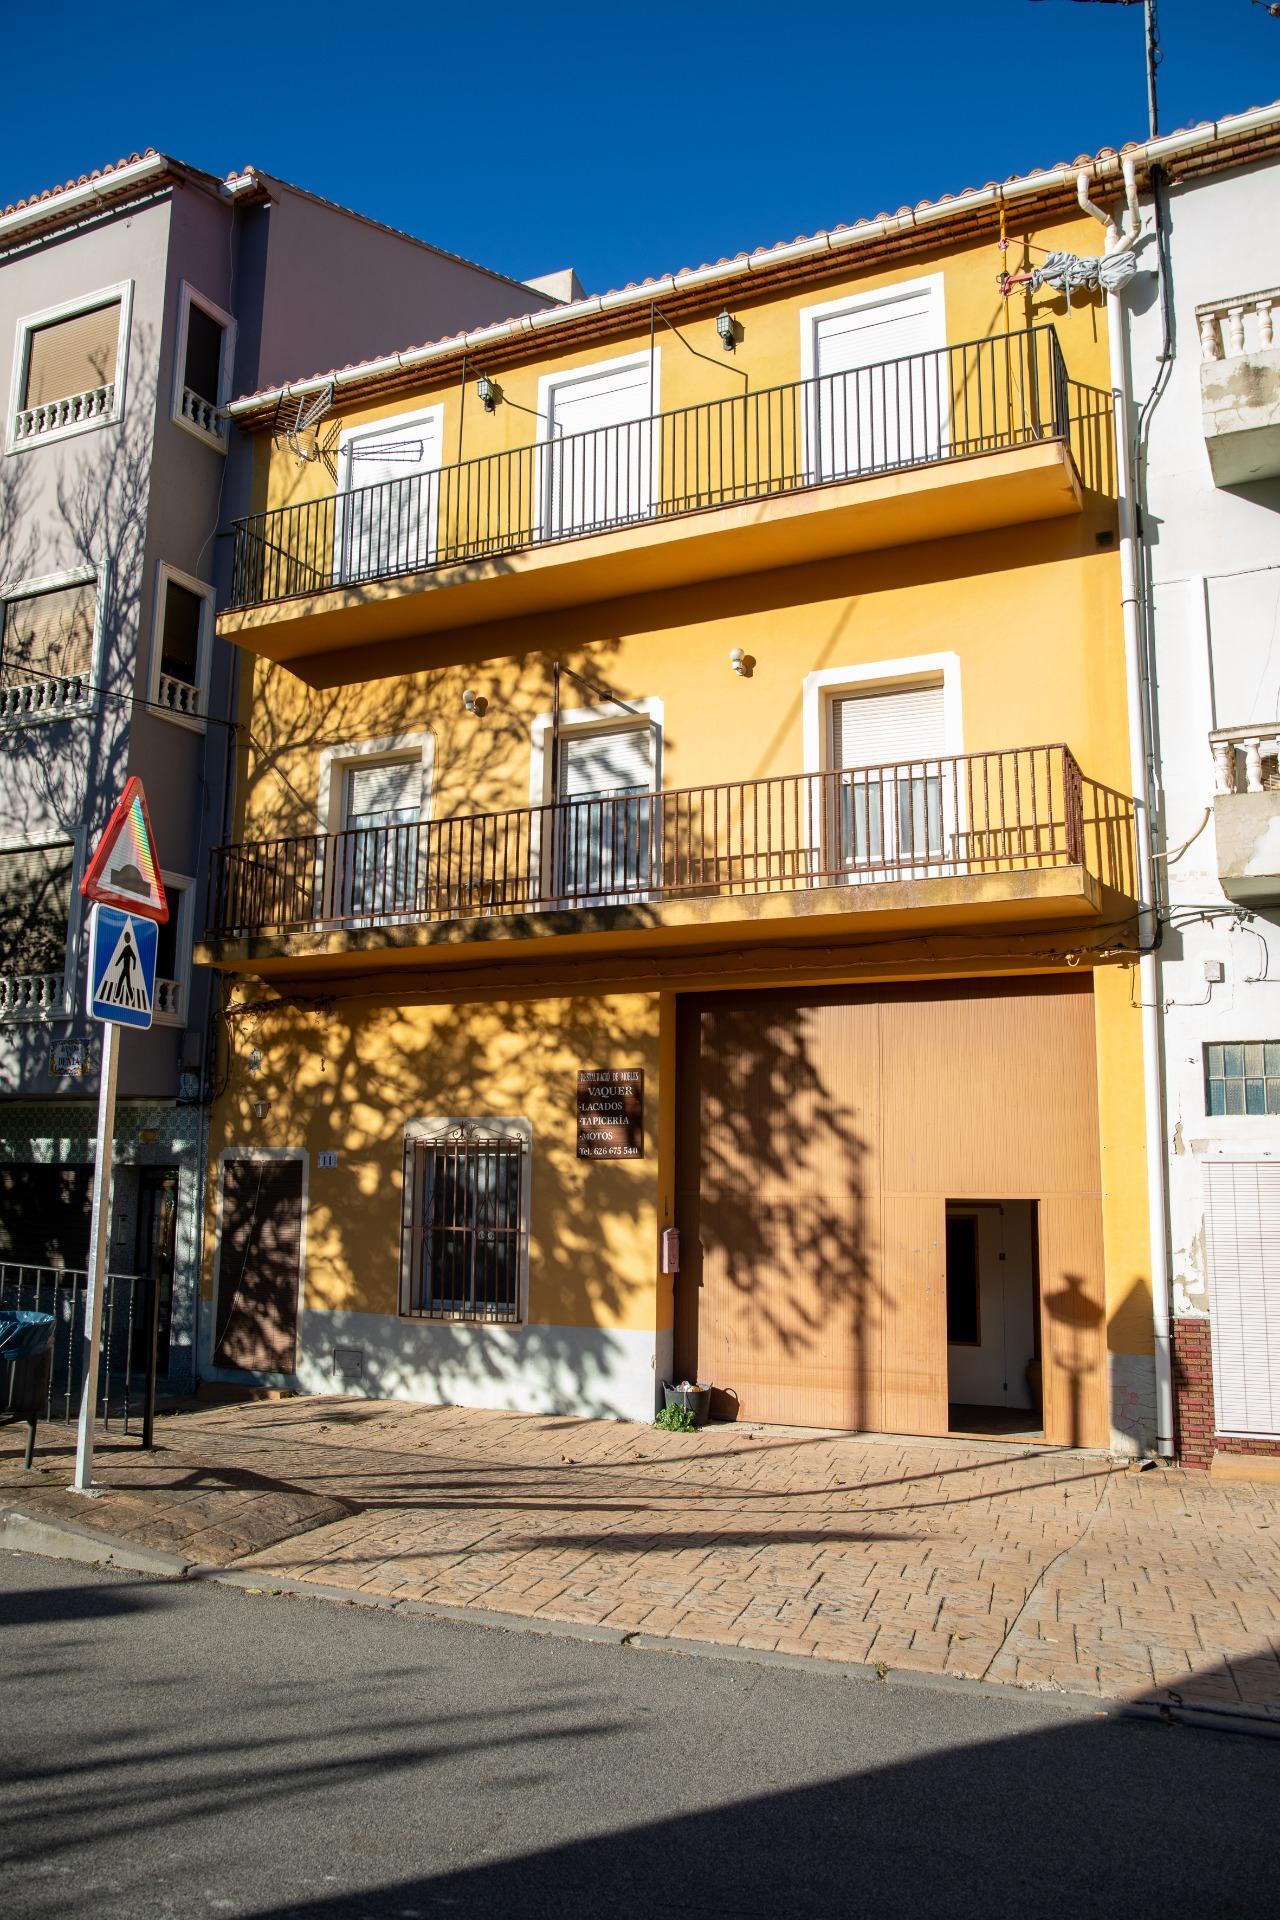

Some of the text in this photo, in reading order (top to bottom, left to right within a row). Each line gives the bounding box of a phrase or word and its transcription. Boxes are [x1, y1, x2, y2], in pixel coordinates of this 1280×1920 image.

[612, 1072, 619, 1081] DE
[588, 1086, 633, 1098] VAQUER
[580, 1146, 638, 1156] Tel. 626 675 540
[323, 1155, 332, 1166] 11
